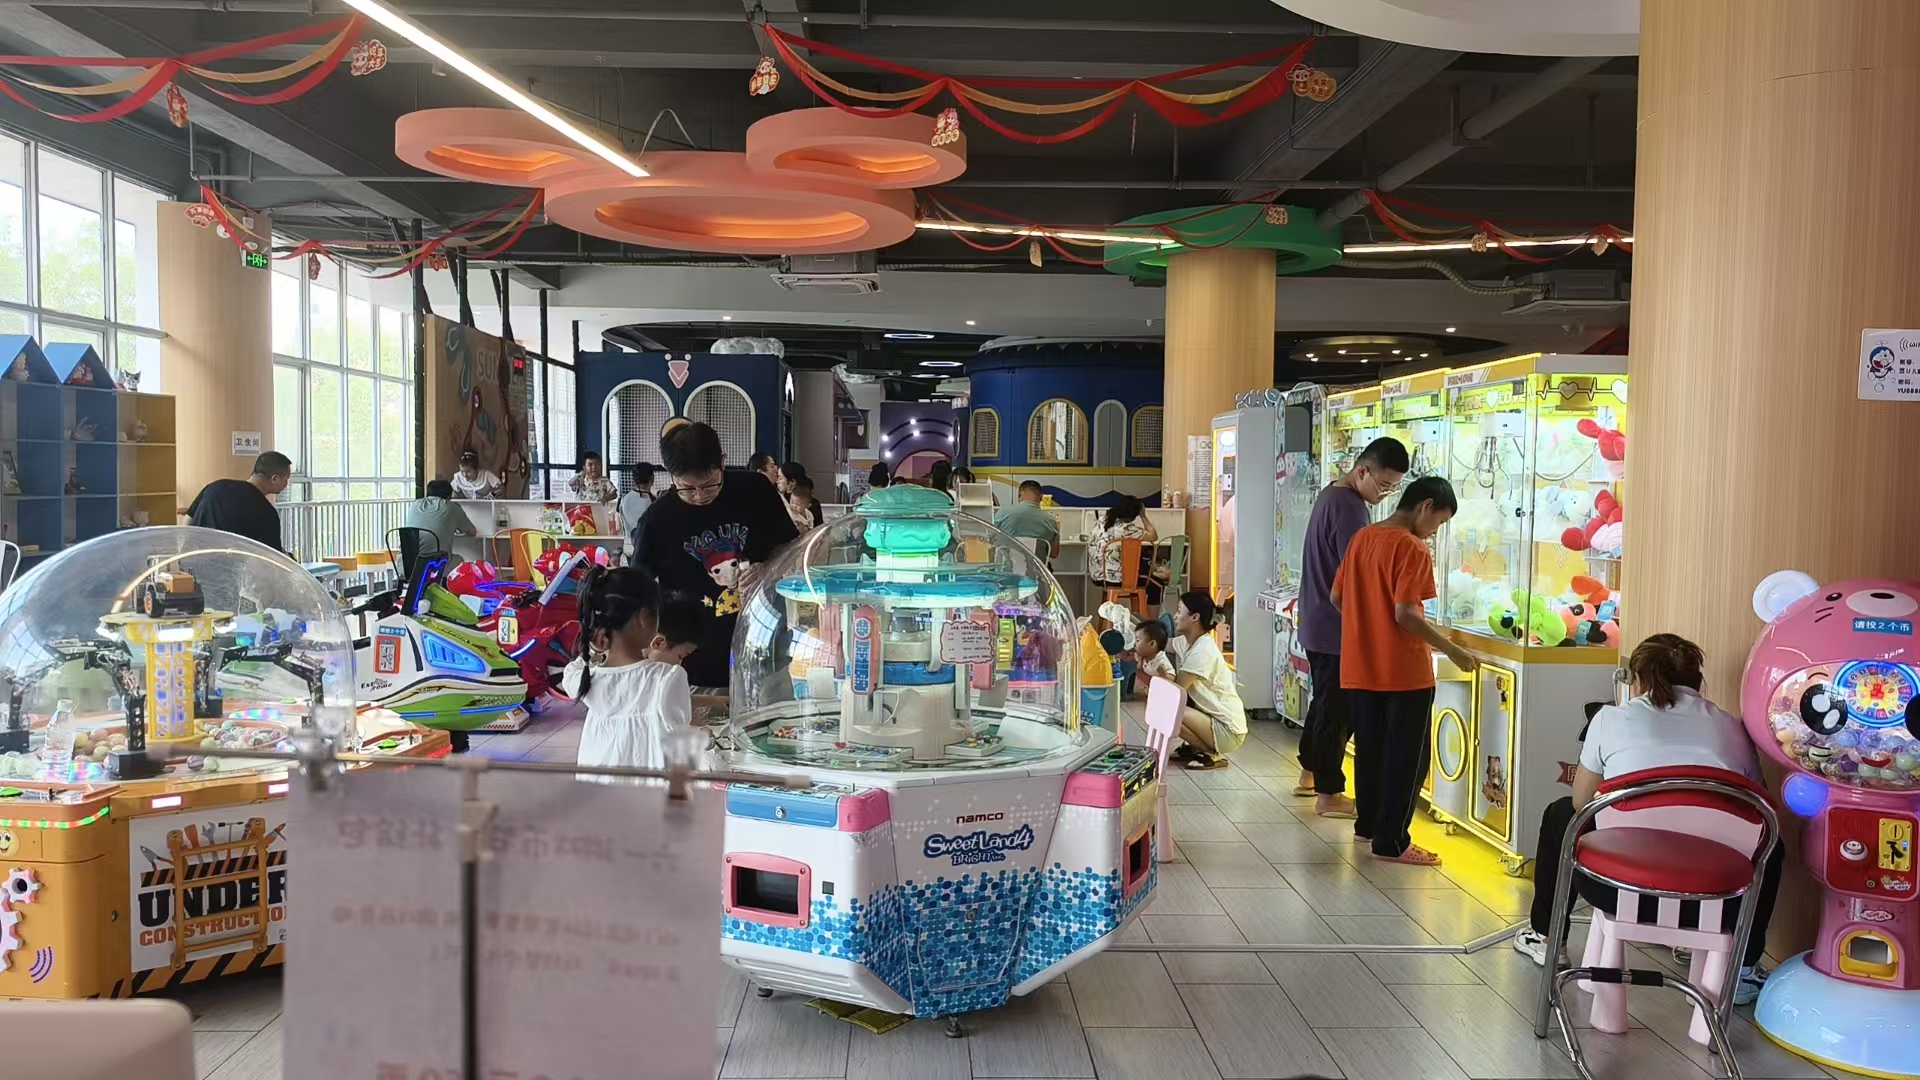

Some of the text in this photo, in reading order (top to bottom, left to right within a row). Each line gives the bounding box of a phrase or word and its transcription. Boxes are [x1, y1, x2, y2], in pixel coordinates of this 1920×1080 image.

[234, 437, 260, 447] 卫生间
[1854, 620, 1910, 632] 请投2个币
[956, 812, 1004, 824] namco
[138, 869, 286, 928] UNDER
